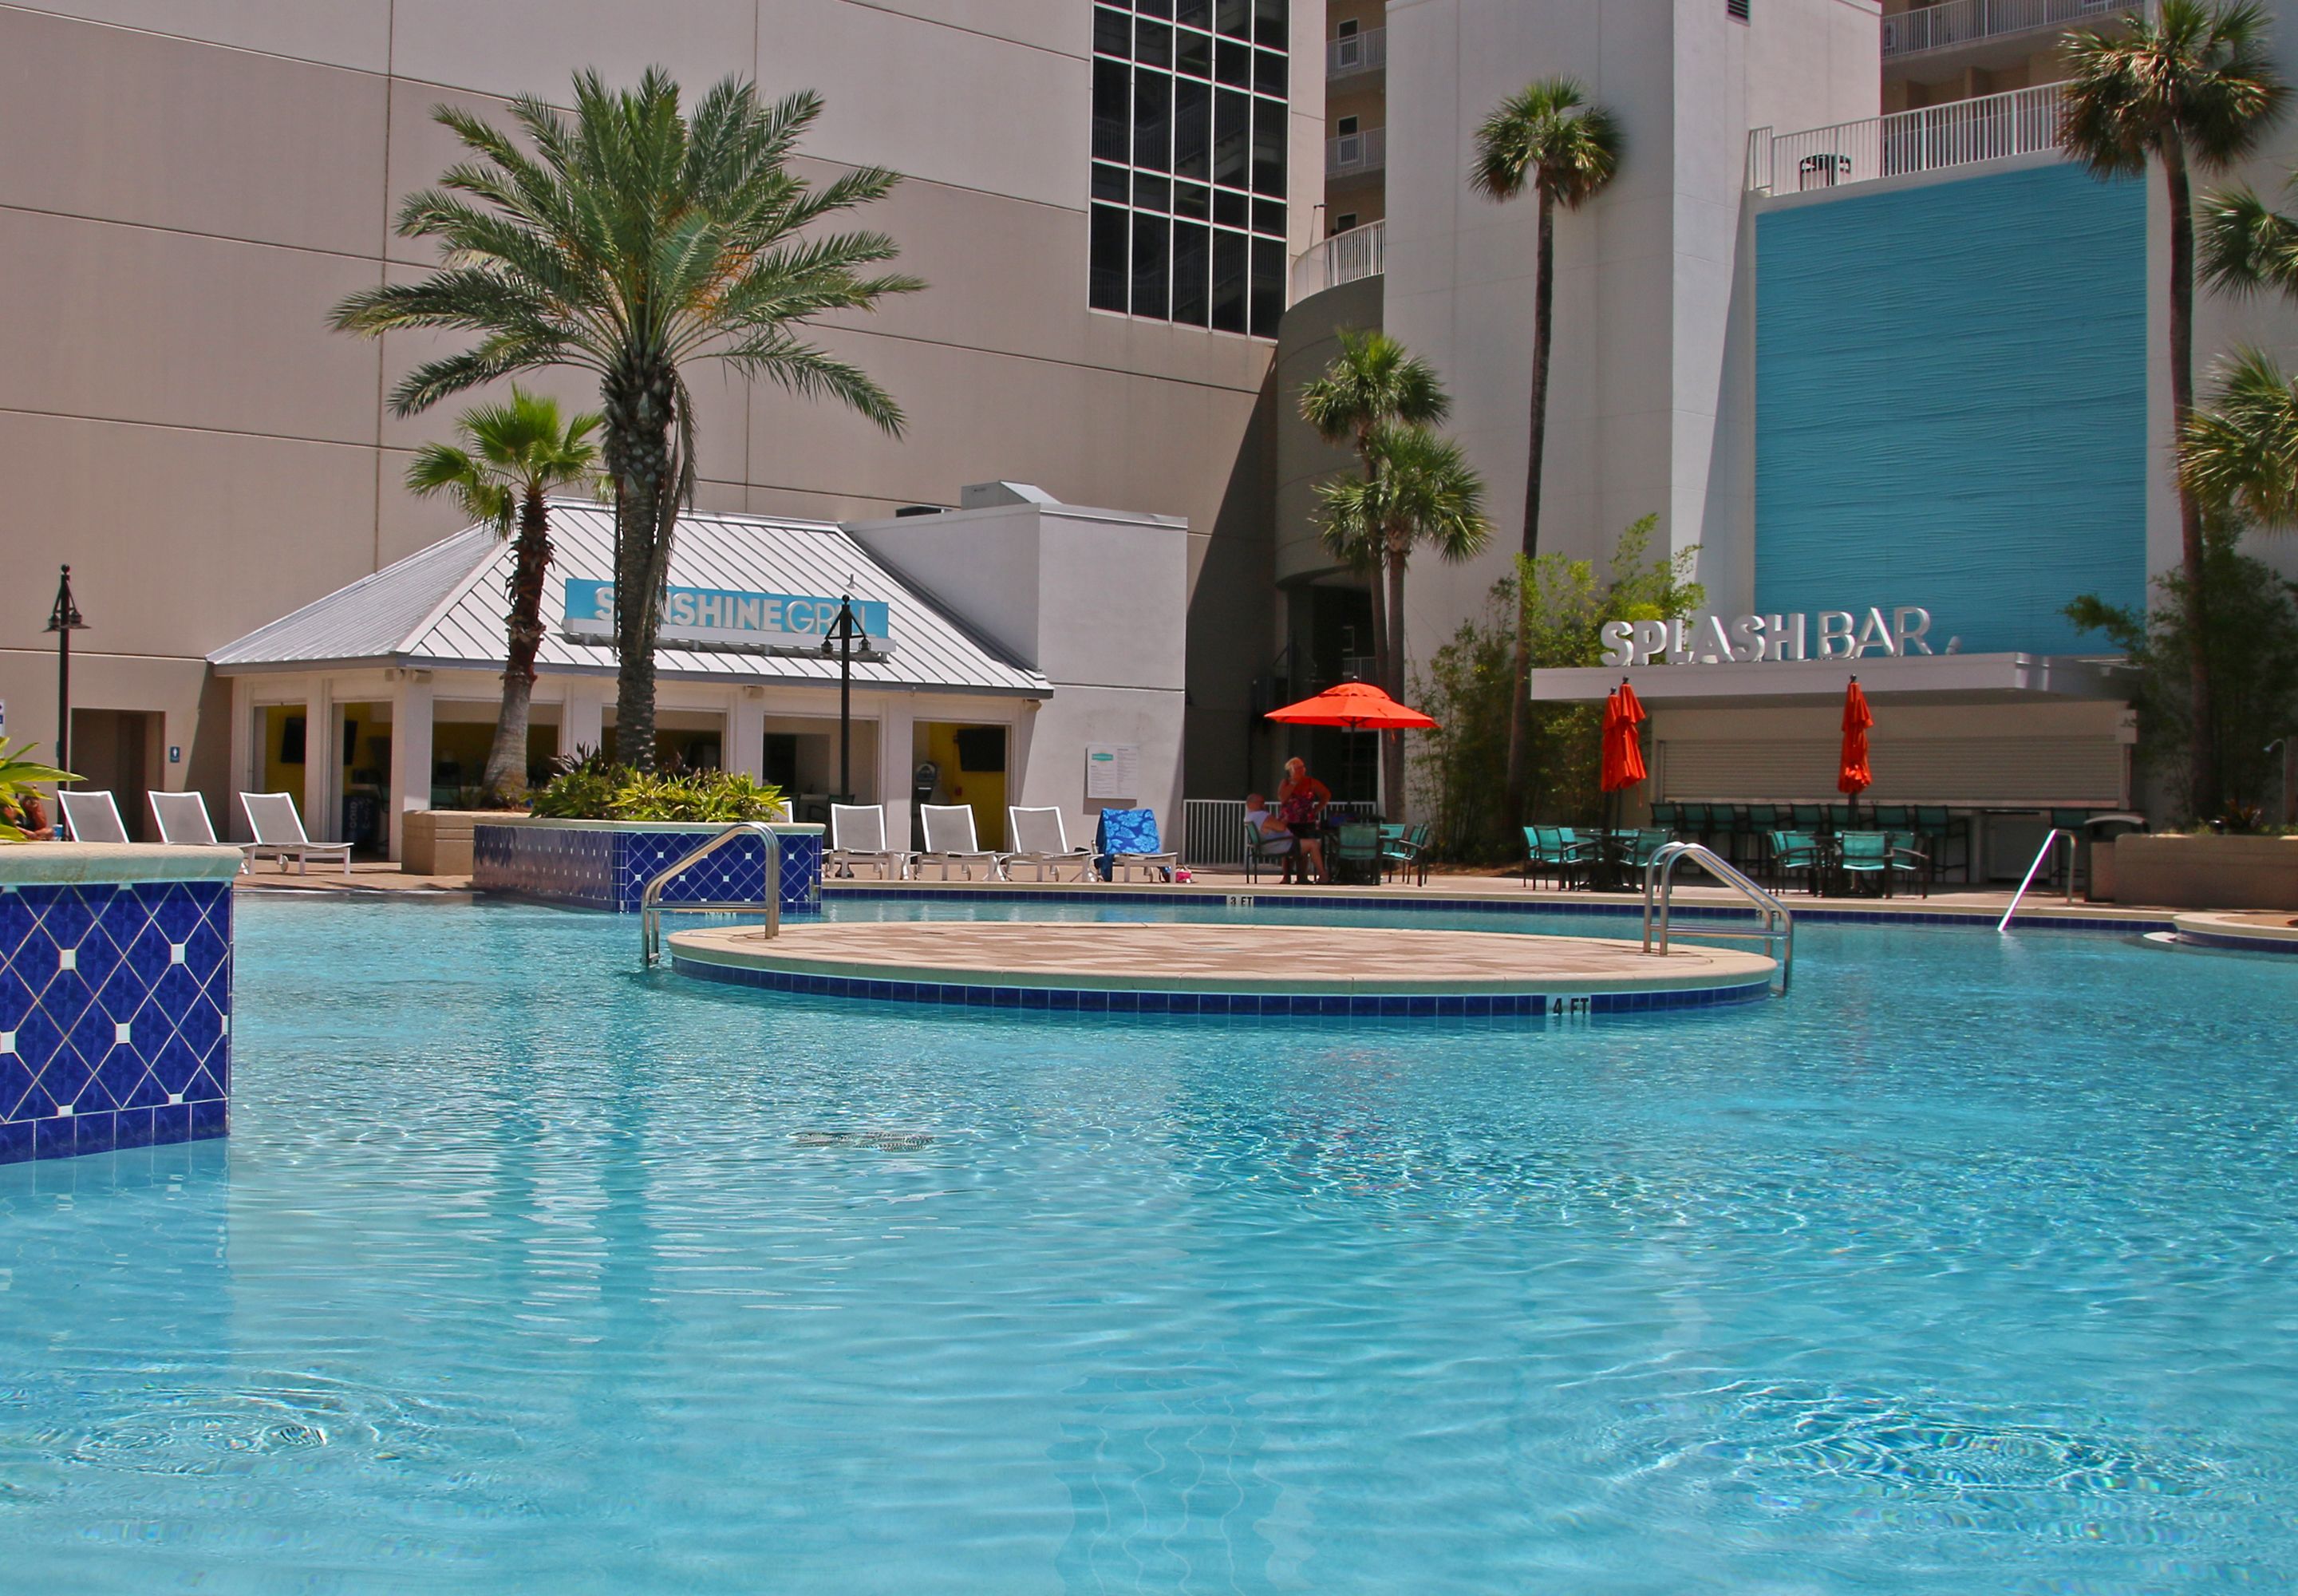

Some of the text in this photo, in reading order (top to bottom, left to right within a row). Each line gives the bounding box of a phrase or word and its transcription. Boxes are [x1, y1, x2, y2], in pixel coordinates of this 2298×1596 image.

[594, 587, 781, 631] SNSHINE
[1600, 606, 1932, 667] SPLASH BAR
[1230, 896, 1252, 907] 3 FT
[1553, 998, 1589, 1014] 4 FT
